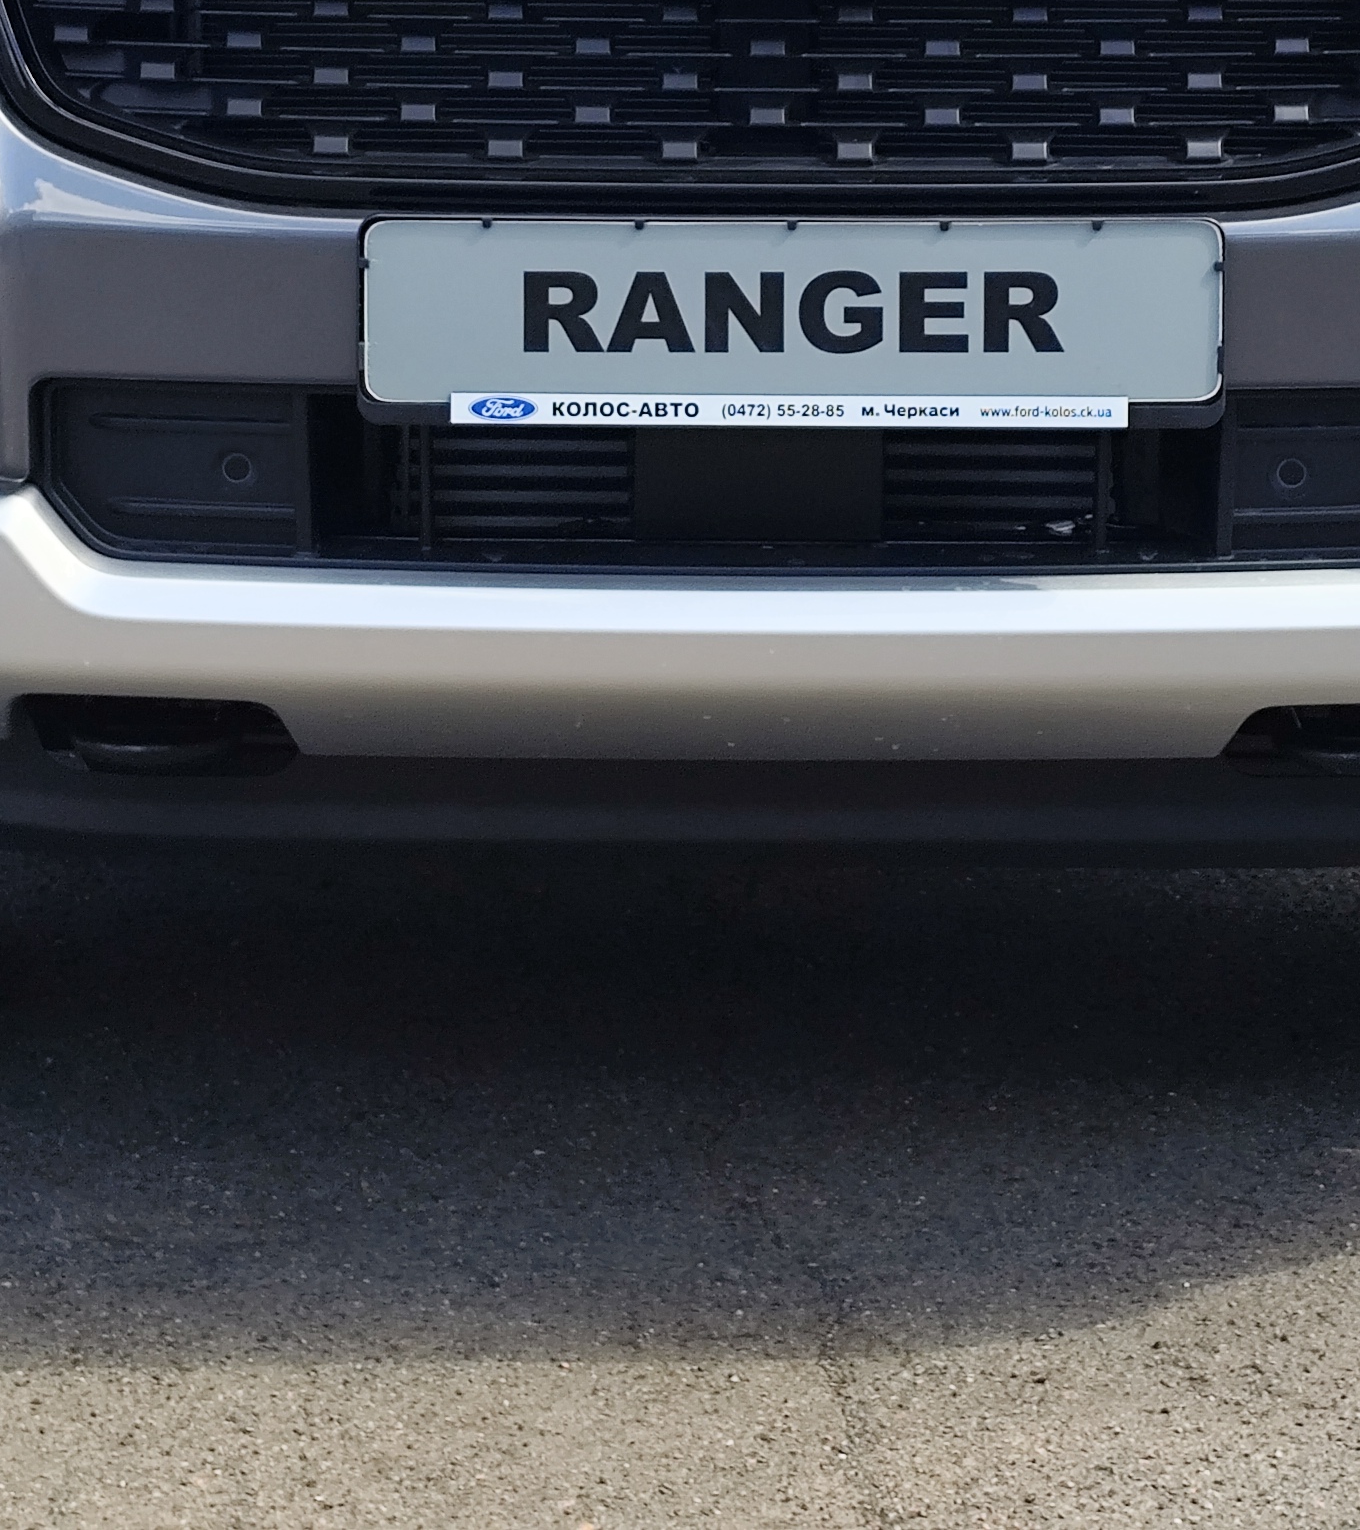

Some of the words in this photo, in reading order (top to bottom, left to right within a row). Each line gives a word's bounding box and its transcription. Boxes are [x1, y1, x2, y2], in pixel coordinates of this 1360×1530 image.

[522, 270, 1065, 355] RANGER
[479, 398, 524, 418] Ford
[552, 401, 700, 418] КОЛОС-АВТО
[721, 403, 771, 420] (0472)
[777, 403, 845, 418] 55-28-85
[861, 406, 880, 417] м.
[883, 403, 960, 421] Черкаси
[979, 404, 1113, 418] www.ford-kolos.ck.ua
